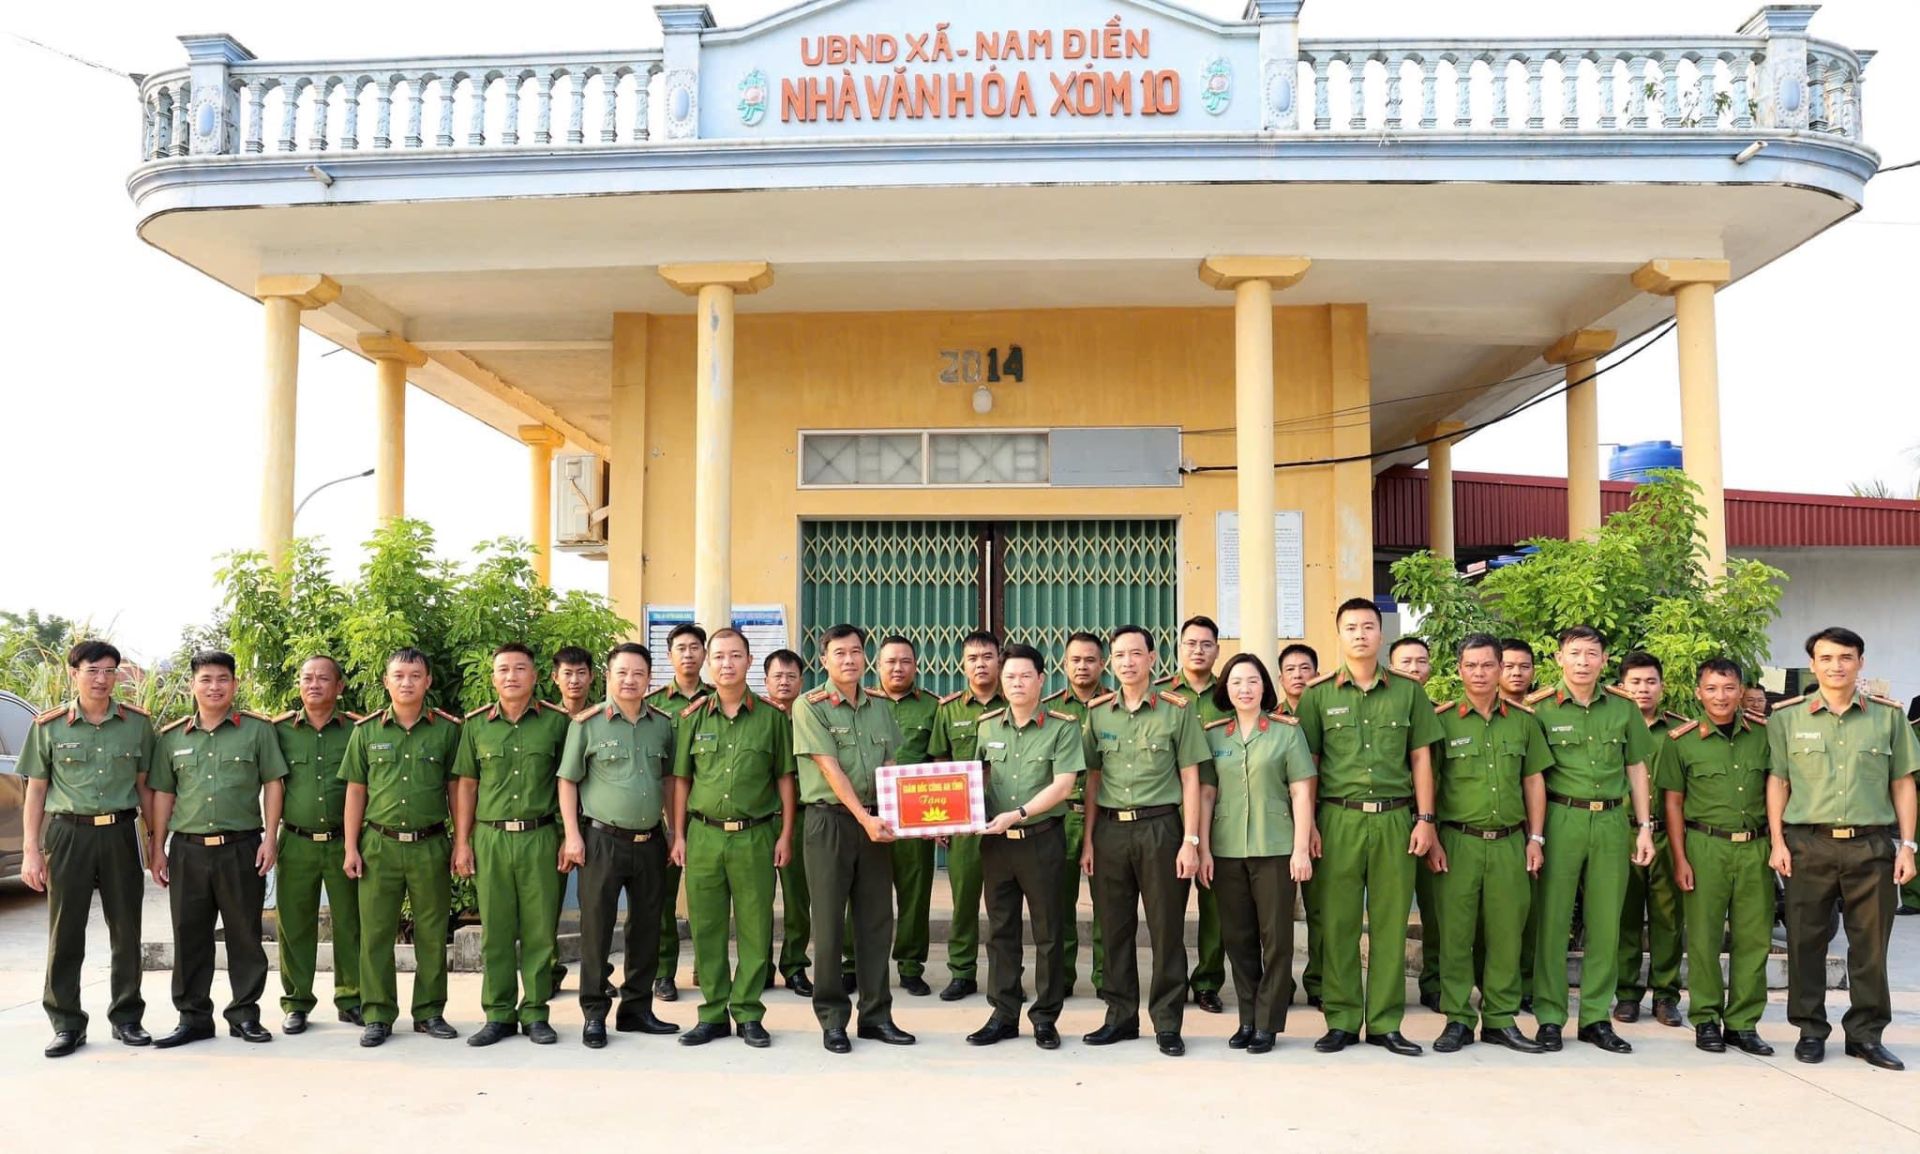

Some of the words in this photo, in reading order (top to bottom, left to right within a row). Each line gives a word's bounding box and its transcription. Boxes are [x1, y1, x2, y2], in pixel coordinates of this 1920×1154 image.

[800, 32, 898, 67] UBND
[904, 22, 954, 62] XÃ
[975, 30, 1053, 62] NAM
[781, 68, 862, 123] NHÀ
[864, 65, 942, 121] VĂN
[946, 64, 1037, 119] HÓA
[1049, 62, 1133, 118] XÓM
[1139, 69, 1181, 117] 10
[939, 344, 1024, 383] 2014
